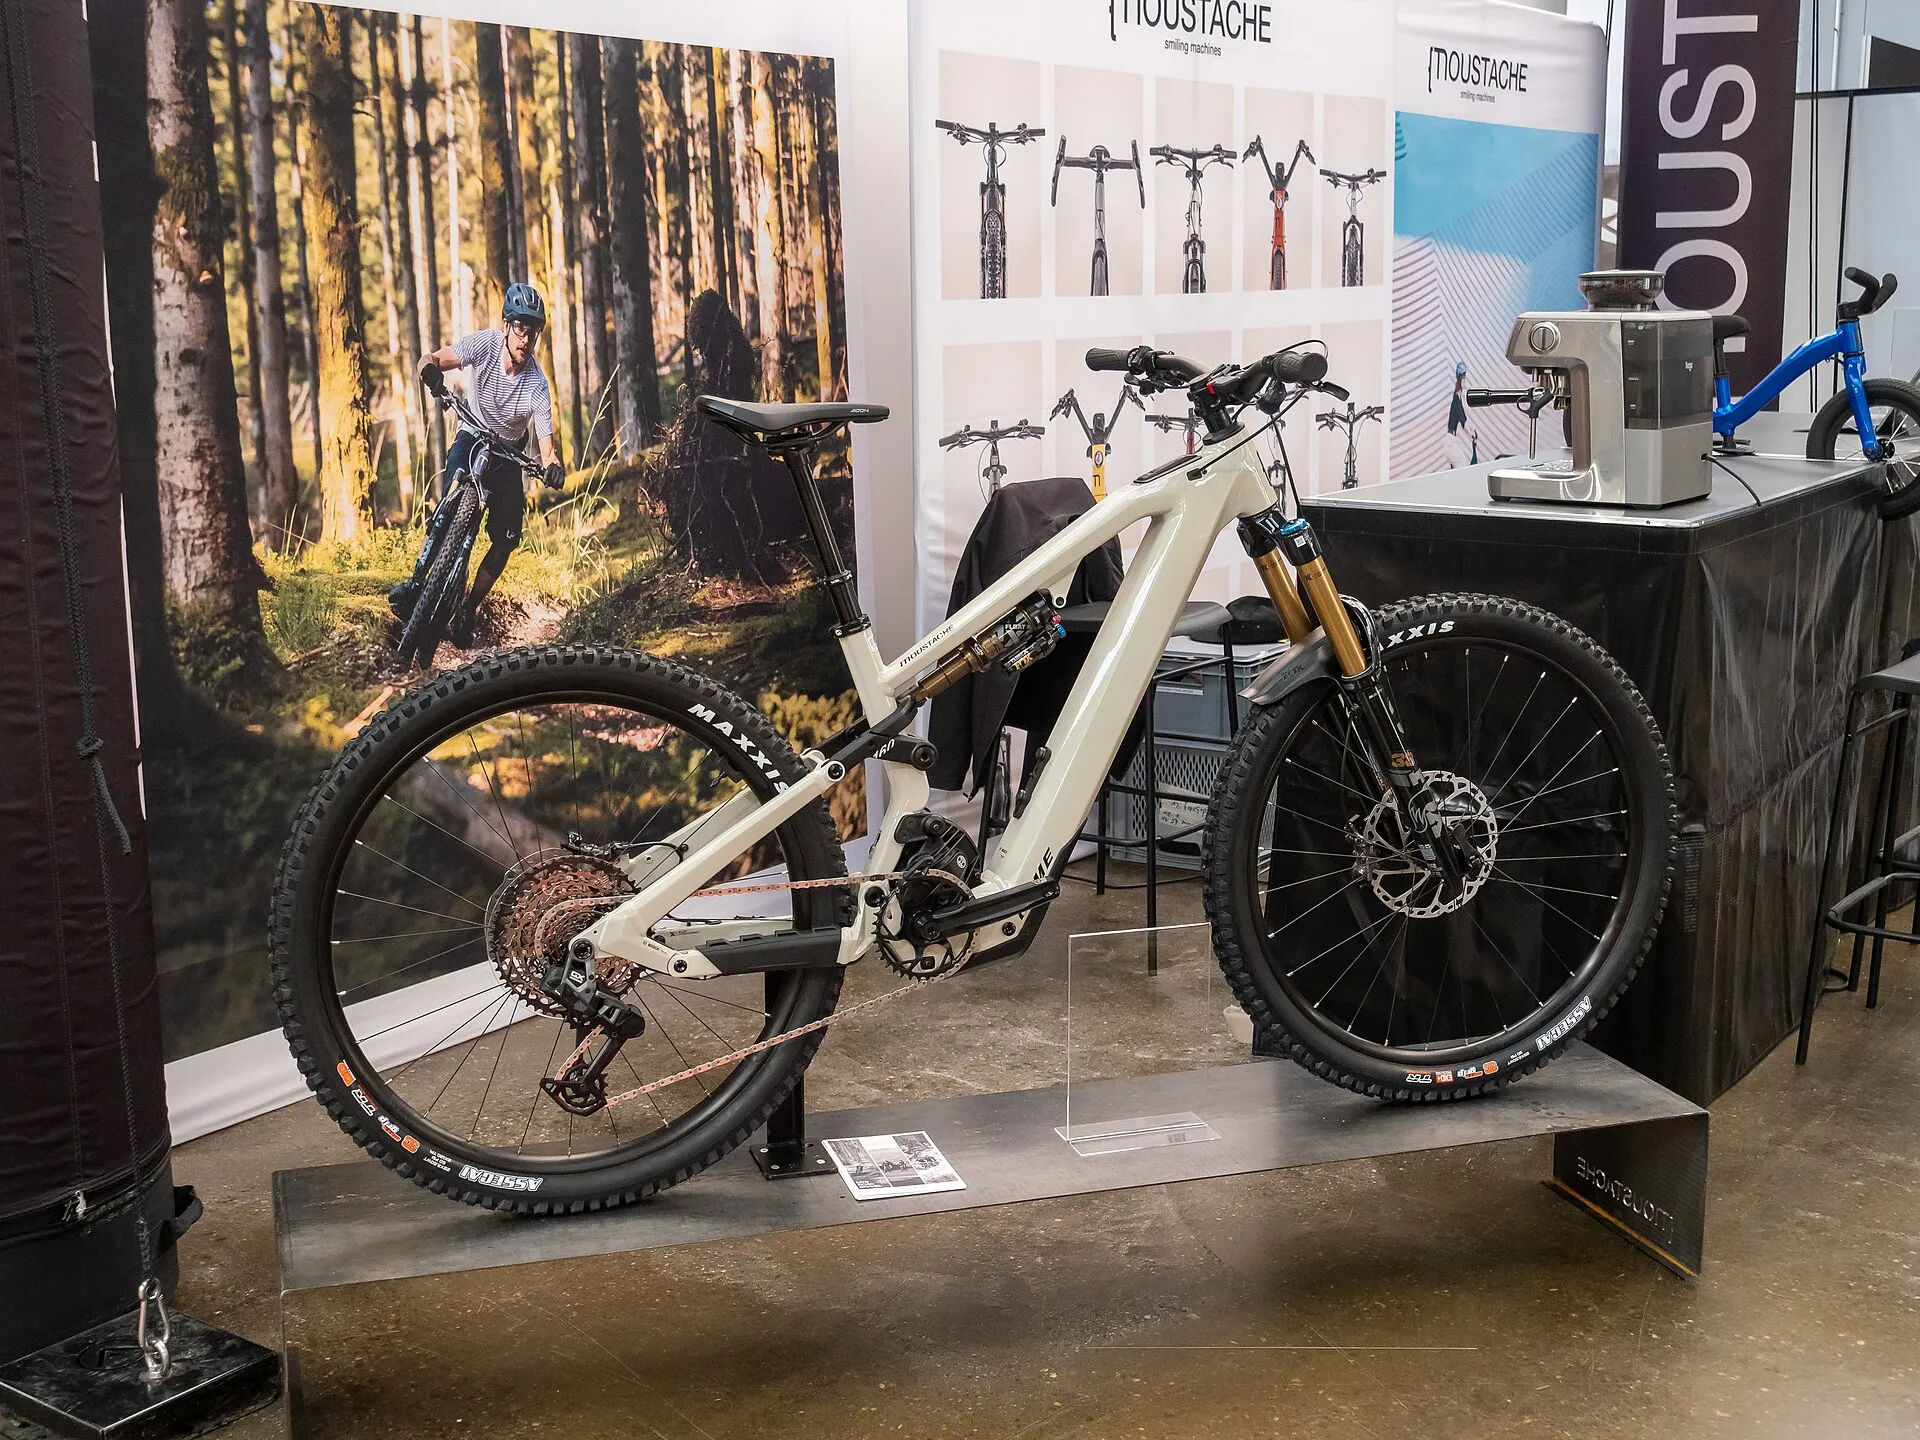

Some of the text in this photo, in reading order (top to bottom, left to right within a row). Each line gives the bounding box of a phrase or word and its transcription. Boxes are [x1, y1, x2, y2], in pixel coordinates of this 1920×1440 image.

[1164, 38, 1222, 57] smiling machines
[1428, 46, 1528, 93] MOUSTACHE
[1653, 0, 1758, 353] OUST
[900, 623, 955, 667] MOUSTACHE
[1380, 621, 1455, 651] XXIS
[1535, 996, 1592, 1051] ASSEGAI
[459, 1164, 543, 1191] ASSEGAI
